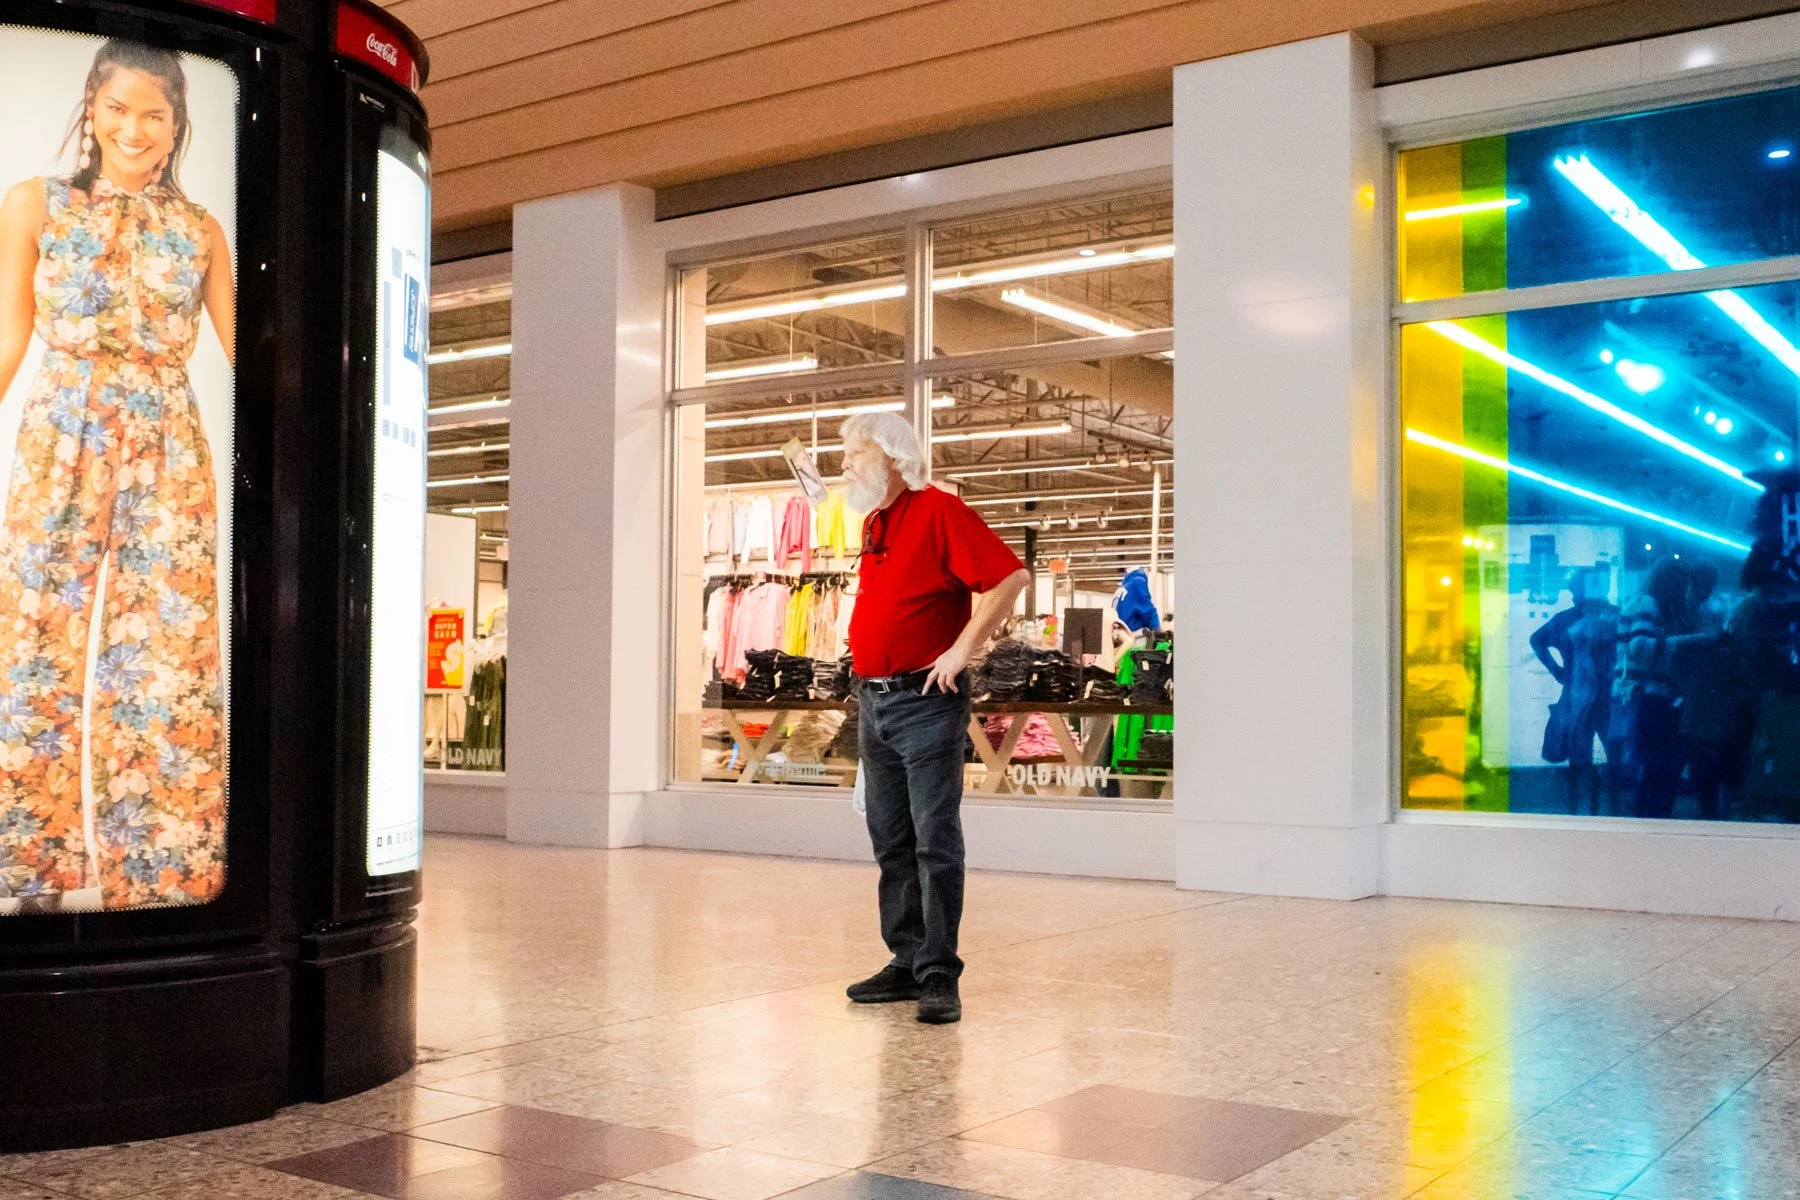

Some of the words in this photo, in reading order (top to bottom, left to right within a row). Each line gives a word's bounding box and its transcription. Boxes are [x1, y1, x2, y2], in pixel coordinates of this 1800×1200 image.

[434, 630, 457, 639] CASH
[466, 748, 502, 766] NAVY
[1012, 764, 1051, 786] OLD
[1056, 766, 1111, 788] NAVY
